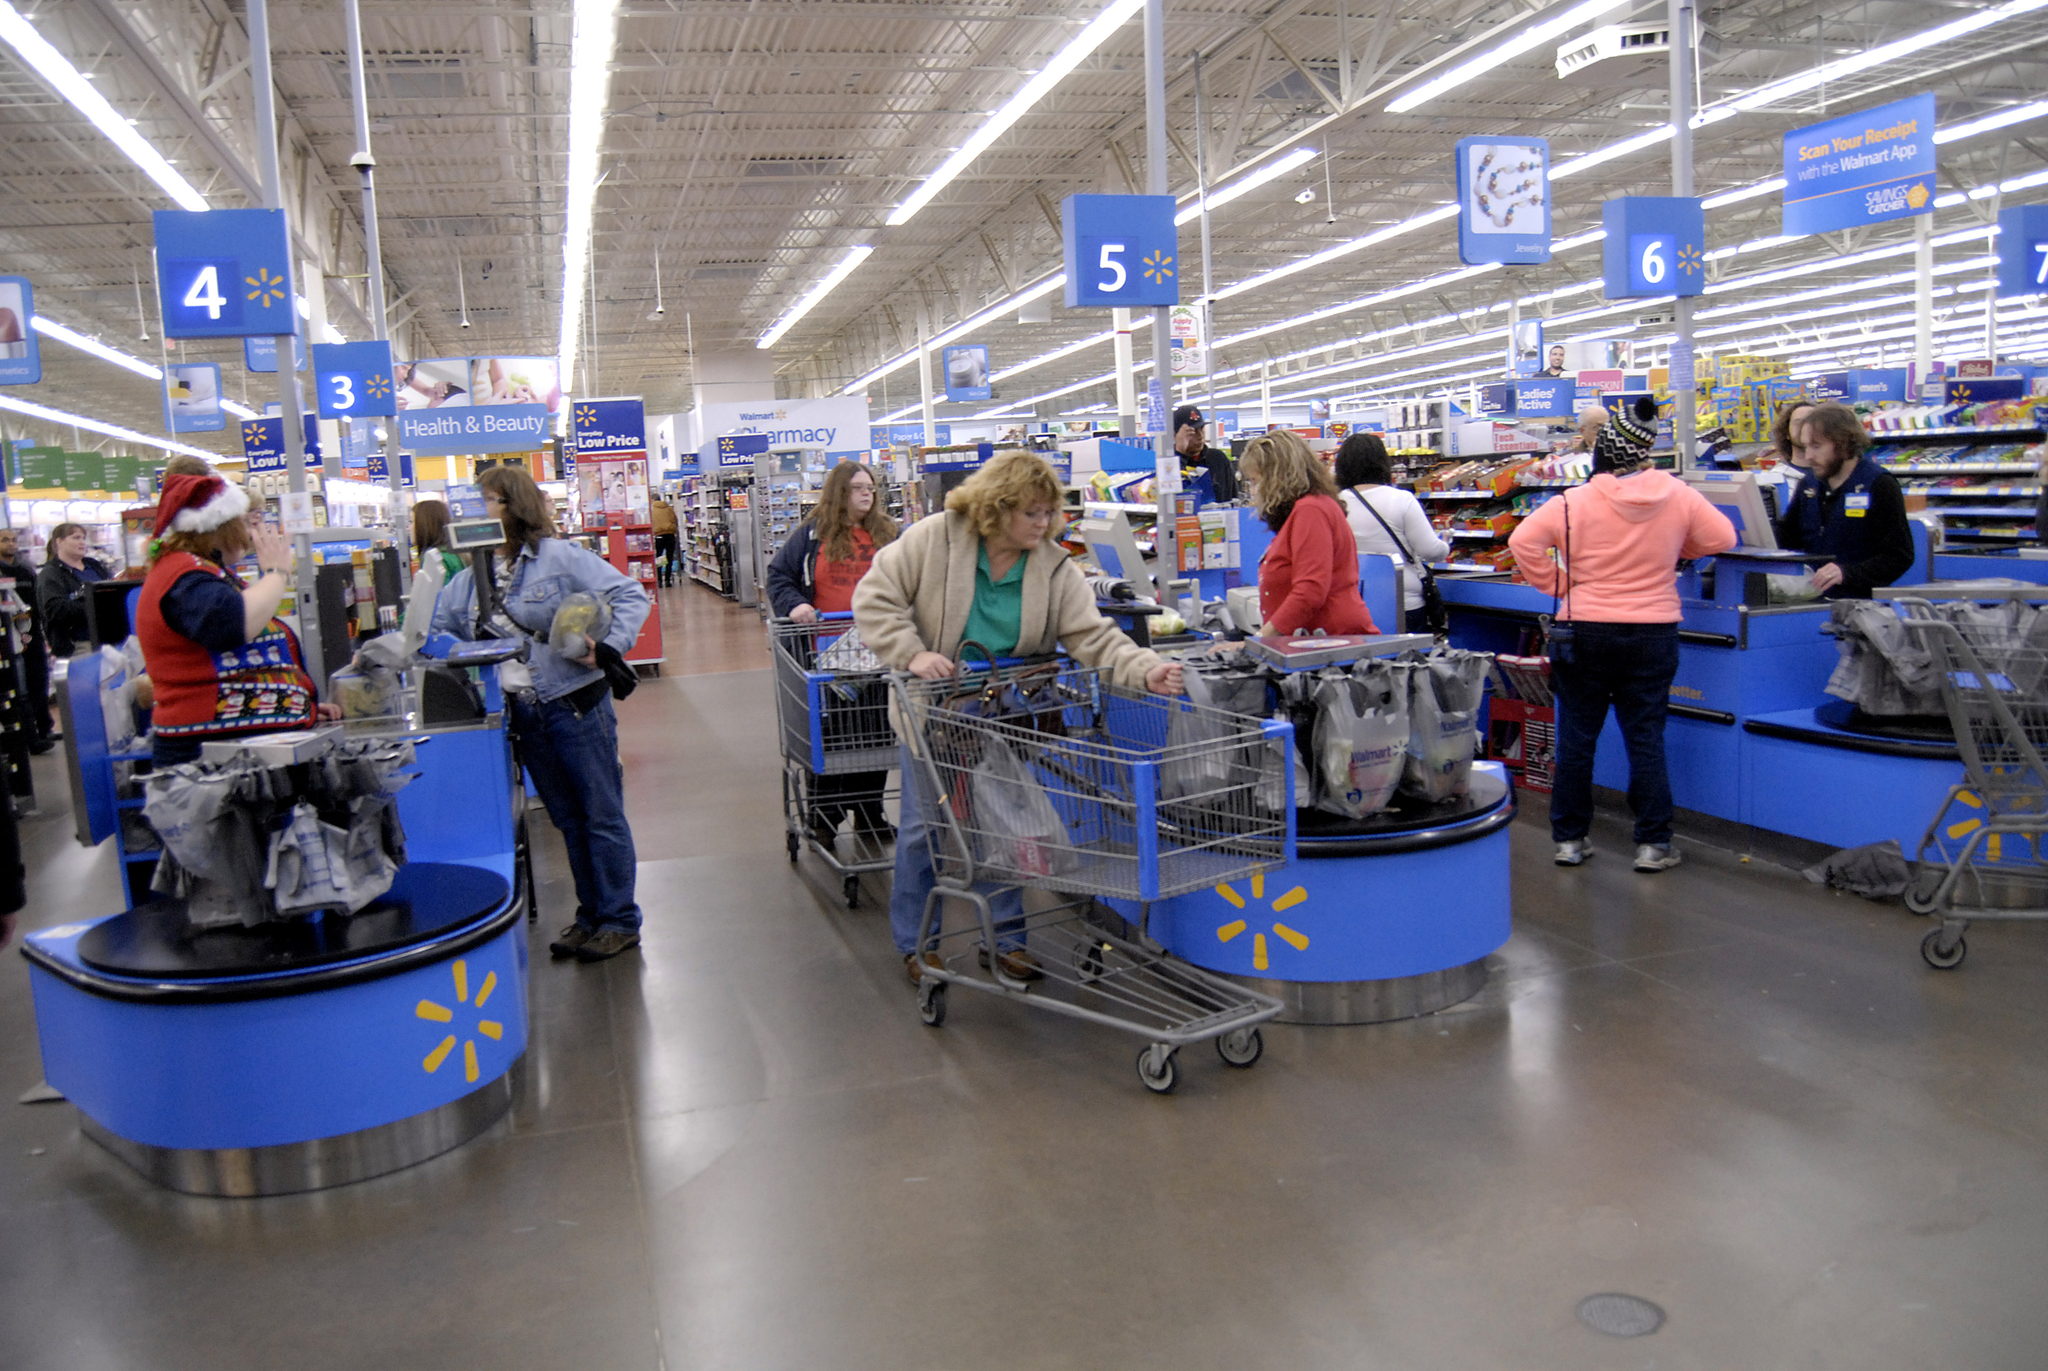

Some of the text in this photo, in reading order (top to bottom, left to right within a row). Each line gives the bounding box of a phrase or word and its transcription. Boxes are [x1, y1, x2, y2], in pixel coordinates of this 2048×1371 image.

[1799, 118, 1918, 162] Scan Your Receipt
[1797, 144, 1918, 181] with the Walmart App
[1865, 184, 1909, 206] SAVINGS
[1868, 200, 1906, 215] CATCHER
[1514, 242, 1544, 256] Jewelry
[1098, 244, 1126, 292] 5
[1642, 241, 1665, 284] 6
[184, 266, 227, 320] 4
[331, 375, 356, 410] 3
[1516, 400, 1552, 410] Active
[740, 412, 774, 420] Walmart
[404, 414, 544, 437] Health & Beauty
[578, 434, 640, 448] Low Price
[743, 426, 836, 446] armacy
[893, 433, 912, 442] Paper
[1494, 433, 1514, 442] Tech
[1494, 442, 1539, 452] Essentials
[249, 456, 278, 468] Low
[1351, 746, 1391, 764] Walmart
